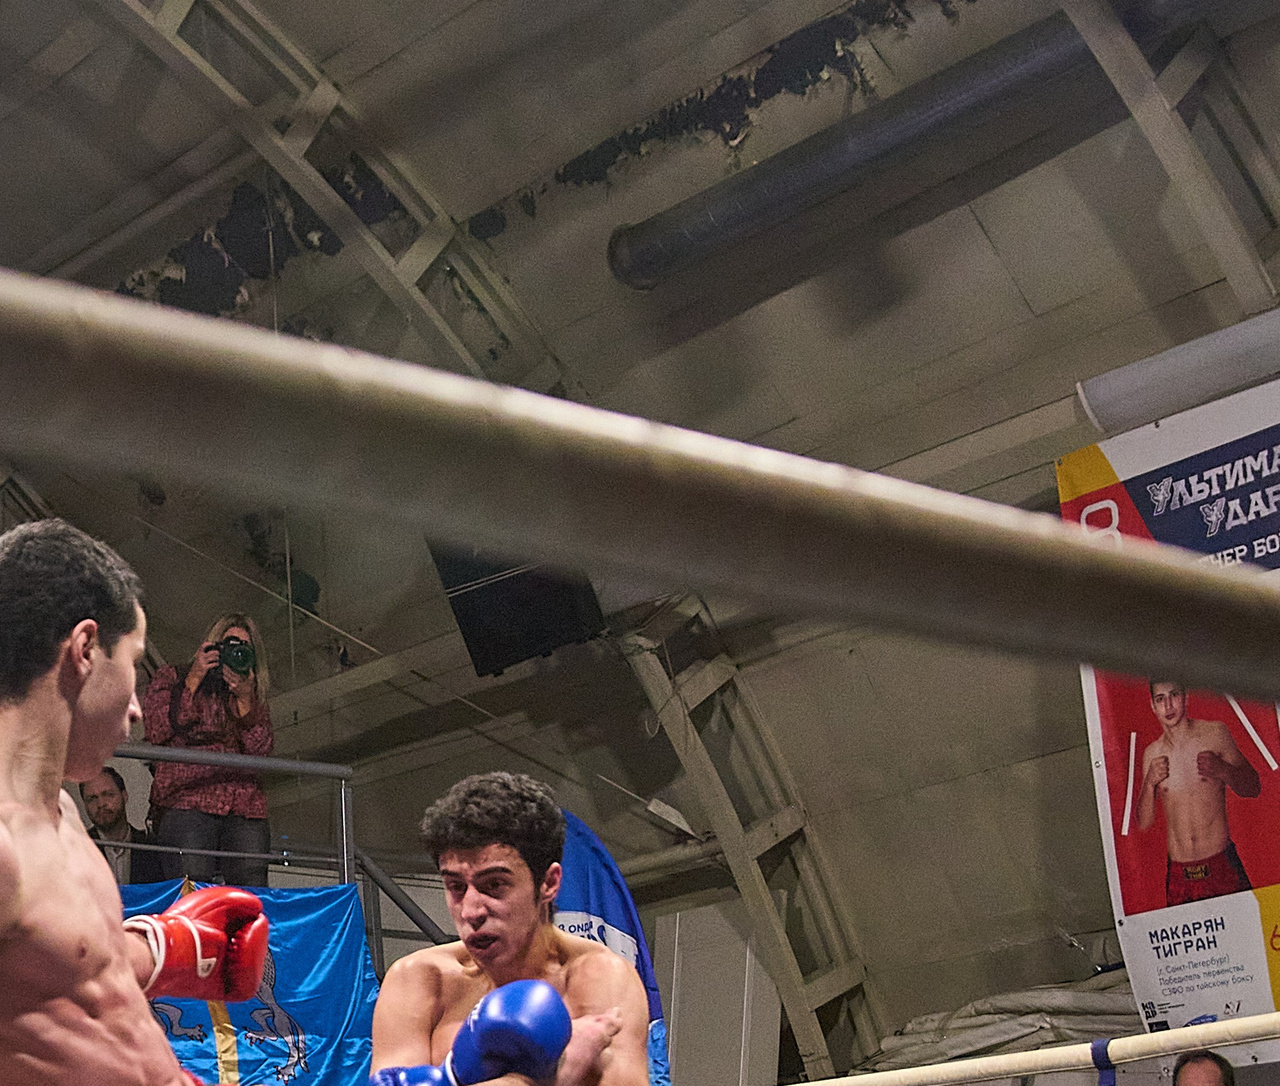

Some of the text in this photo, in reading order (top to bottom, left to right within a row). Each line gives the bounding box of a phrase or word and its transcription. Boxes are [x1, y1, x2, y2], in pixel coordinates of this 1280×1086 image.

[1252, 531, 1280, 558] БО
[1148, 917, 1226, 945] МАКАРЯН
[1152, 935, 1218, 959] ТИГРАН
[1158, 965, 1245, 986] Победитель первенства
[1161, 974, 1254, 997] СЗФО по тайскому боксу
